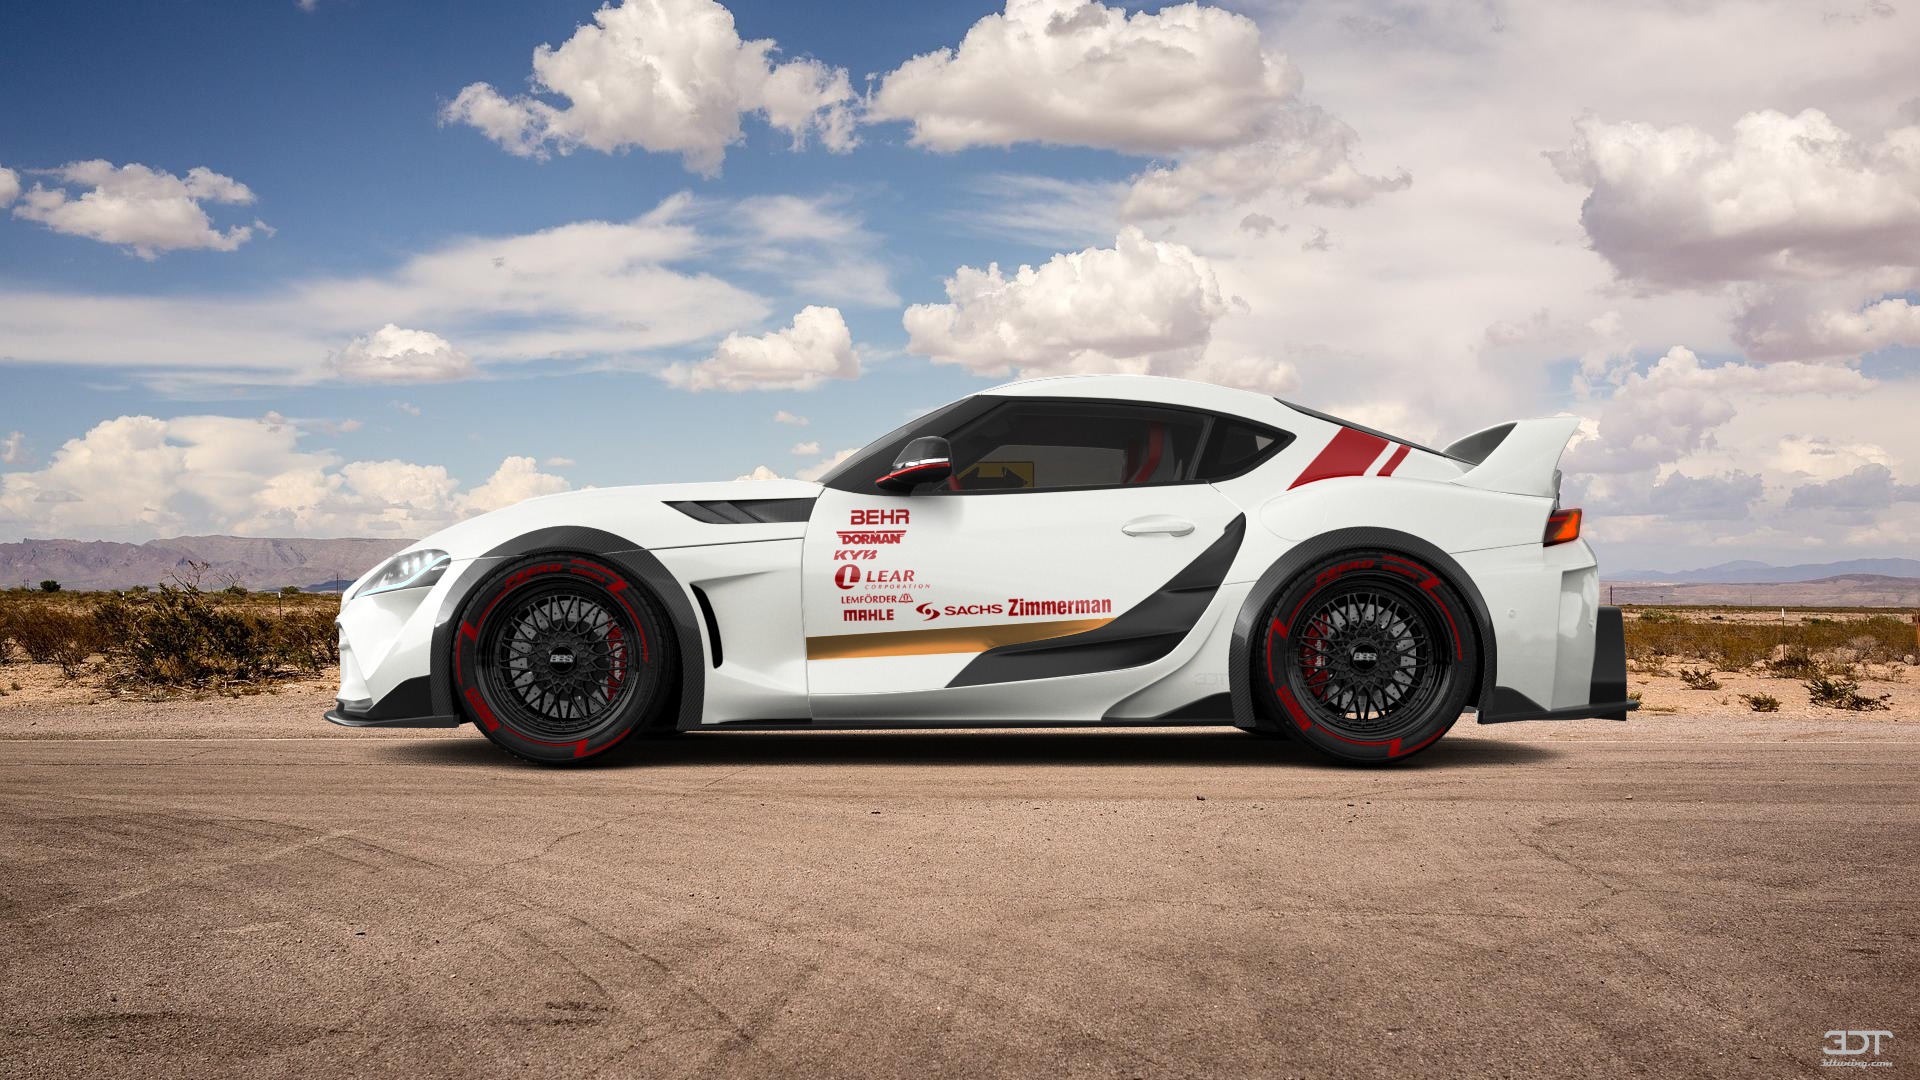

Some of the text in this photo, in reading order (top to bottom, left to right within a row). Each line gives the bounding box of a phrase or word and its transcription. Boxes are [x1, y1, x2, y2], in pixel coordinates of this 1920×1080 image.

[850, 508, 910, 525] BEHR
[839, 532, 902, 545] DORMAN
[833, 549, 878, 561] KYB
[866, 569, 915, 583] LEAR
[841, 593, 897, 604] LEMFÖRDER
[944, 604, 1003, 616] SACHS
[1008, 598, 1112, 617] Zimmerman
[843, 608, 894, 621] MAHLE
